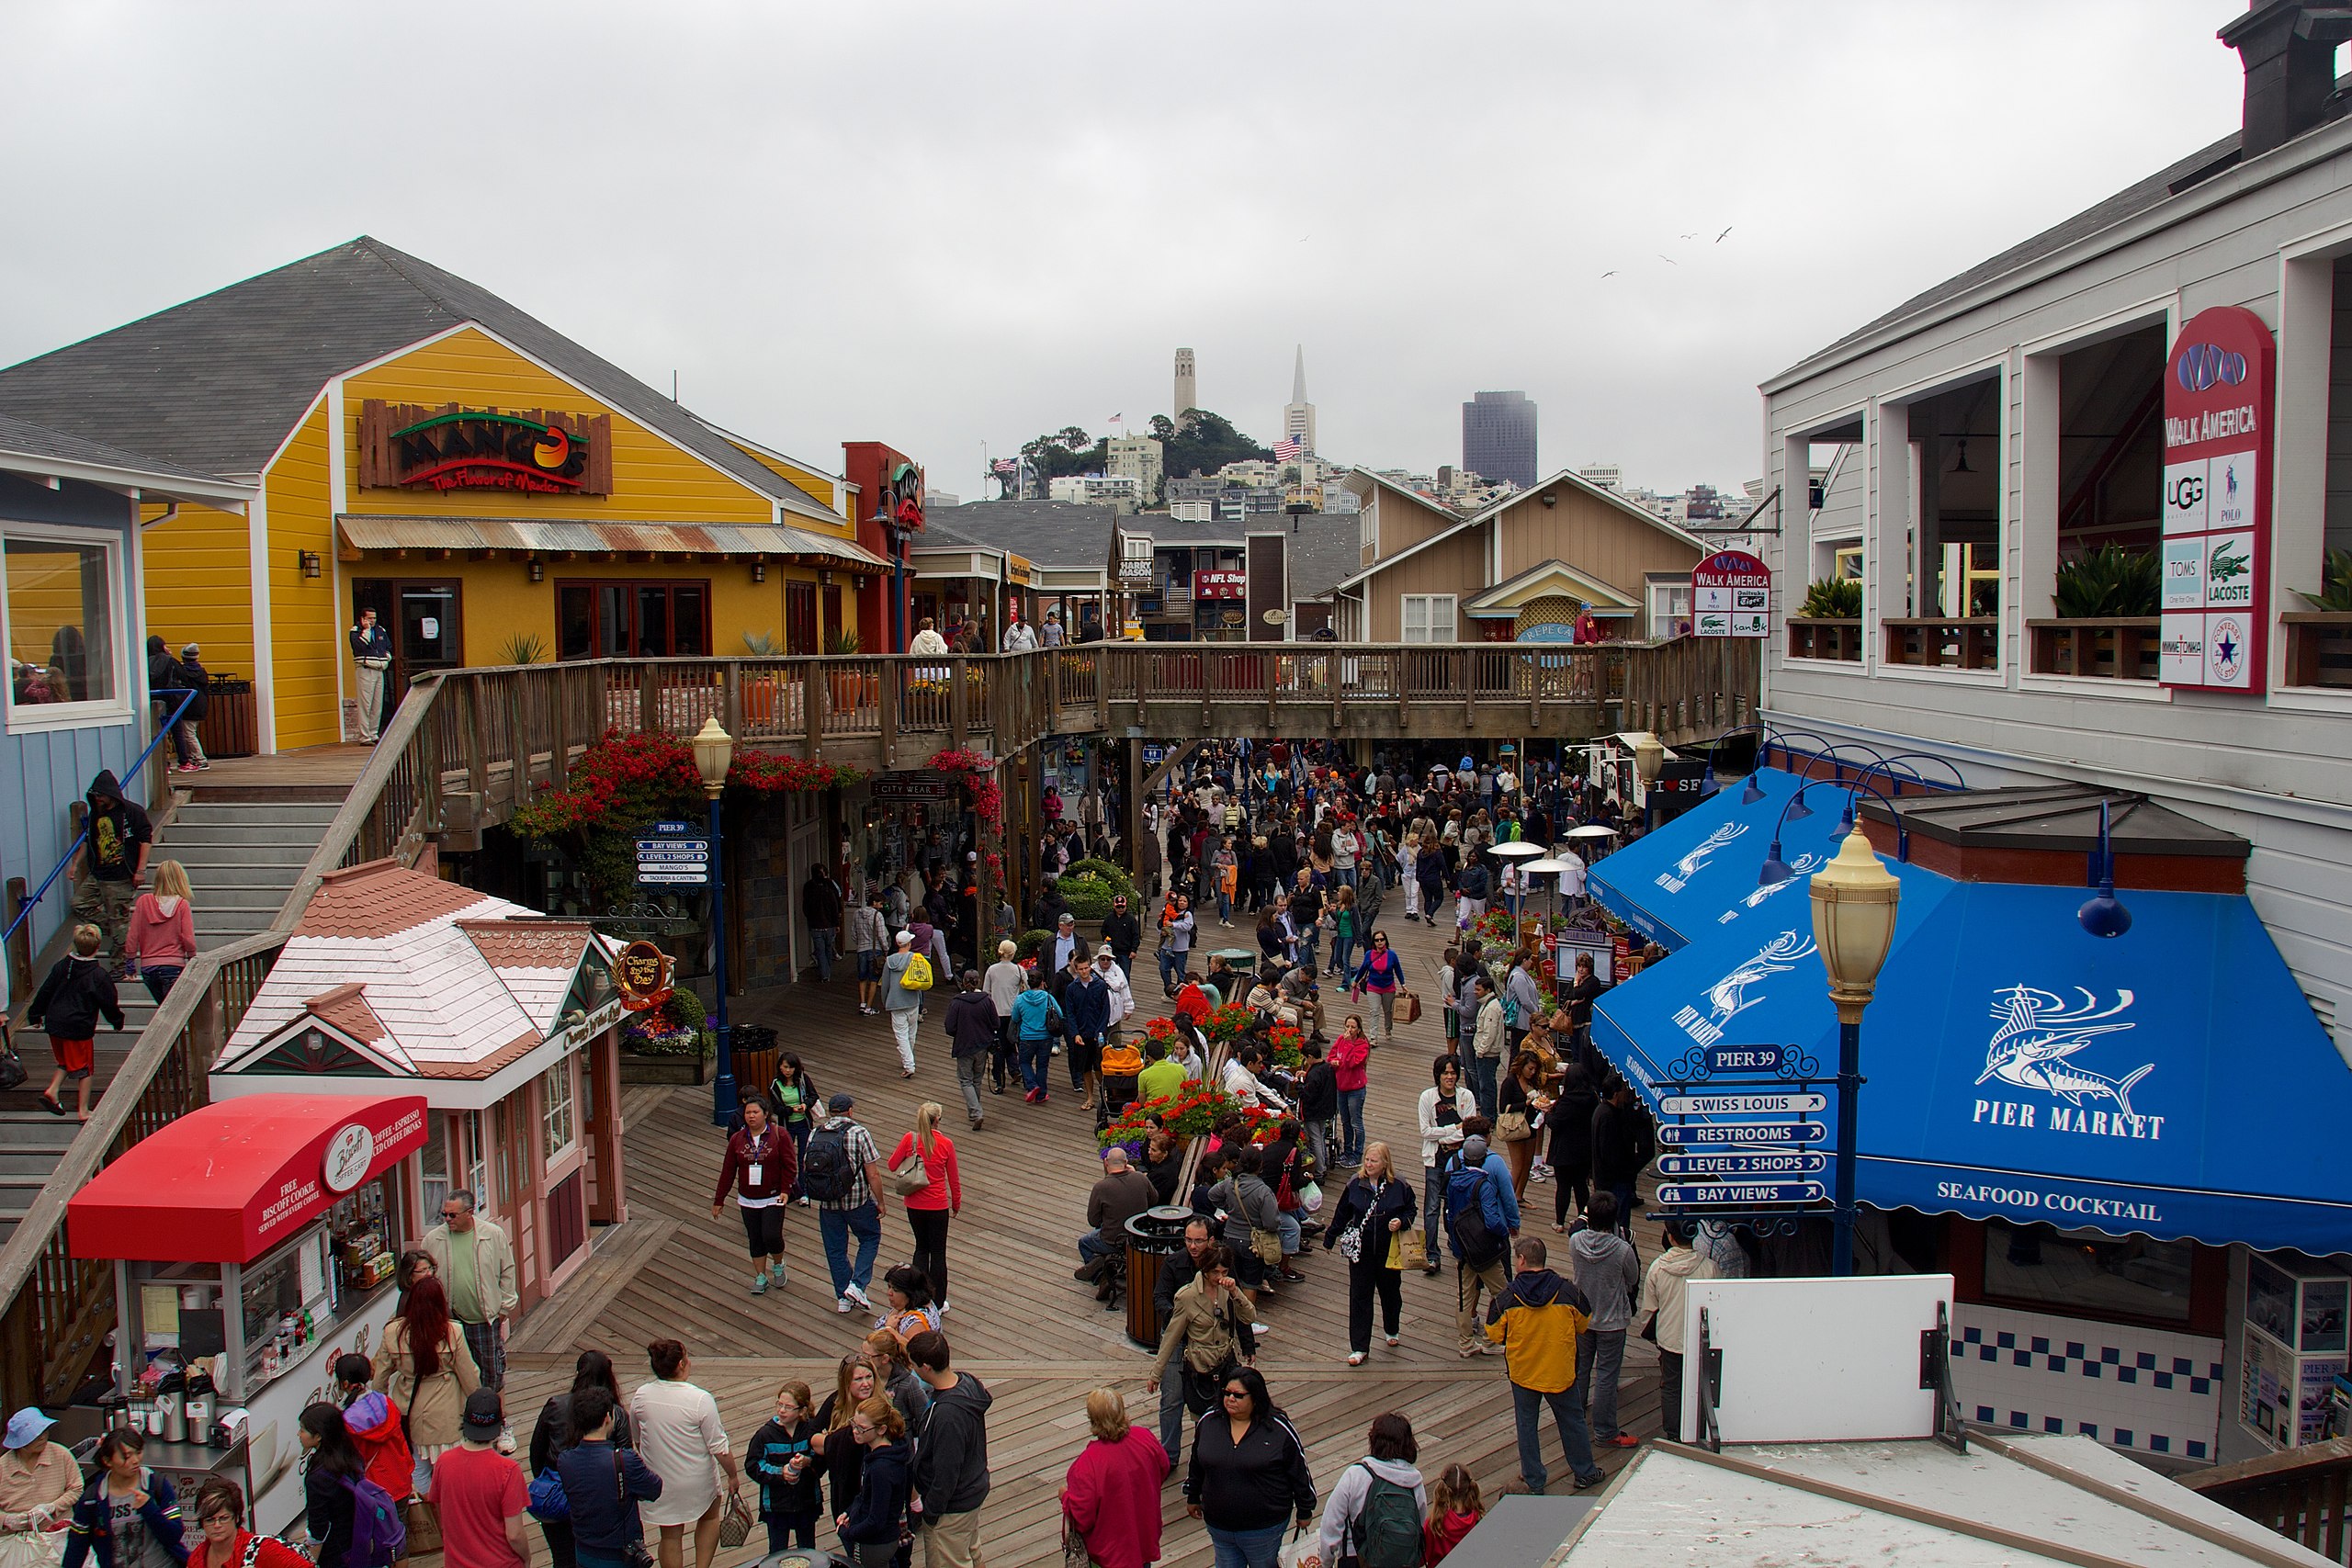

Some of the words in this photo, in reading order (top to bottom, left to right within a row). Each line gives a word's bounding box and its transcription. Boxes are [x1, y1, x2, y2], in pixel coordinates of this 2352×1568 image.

[2165, 416, 2199, 447] WALK
[2200, 405, 2256, 441] AMERICA
[429, 474, 458, 492] The
[458, 468, 499, 488] Flavor
[499, 471, 514, 489] of
[514, 473, 560, 493] Mexico
[2167, 476, 2203, 510] UGG
[2221, 508, 2241, 522] POLO
[1118, 569, 1152, 577] MASON
[1120, 560, 1152, 570] HARRY
[2170, 560, 2196, 577] TOMS
[1210, 573, 1226, 583] NFL
[1227, 573, 1246, 584] Shop
[1696, 572, 1724, 586] WALK
[1726, 573, 1769, 587] AMERICA
[2209, 585, 2249, 602] LACOSTE
[1521, 626, 1555, 642] CREPE
[907, 785, 932, 794] WEAR
[1679, 779, 1702, 792] SF
[626, 955, 660, 965] Charms
[643, 965, 656, 974] the
[633, 974, 655, 985] Bay
[1670, 1004, 1700, 1028] PIER
[1684, 1016, 1724, 1048] MARKET
[1715, 1052, 1756, 1067] PIER
[1758, 1051, 1776, 1066] 39
[1691, 1099, 1739, 1111] SWISS
[1743, 1098, 1789, 1111] LOUIS
[394, 1109, 420, 1132] ESPRESSO
[1973, 1099, 2035, 1129] PIER
[2049, 1106, 2165, 1141] MARKET
[383, 1130, 404, 1150] COFFEE
[403, 1118, 423, 1137] DRINKS
[1696, 1127, 1792, 1141] RESTROOMS
[334, 1168, 354, 1184] COFFEE
[355, 1159, 367, 1172] CART
[1688, 1158, 1734, 1171] LEVEL
[1738, 1158, 1747, 1170] 2
[1751, 1157, 1803, 1170] SHOPS
[280, 1179, 298, 1197] FREE
[1697, 1189, 1727, 1201] BAY
[1730, 1187, 1779, 1200] VIEWS
[263, 1195, 290, 1222] BISCOFF
[290, 1180, 315, 1203] COOKIE
[1937, 1180, 2039, 1208] SEAFOOD
[2043, 1193, 2162, 1222] COCKTAIL
[258, 1217, 277, 1235] SERVED
[277, 1209, 289, 1223] WITH
[288, 1200, 303, 1215] EVERY
[303, 1190, 320, 1206] COFFEE
[2303, 1364, 2329, 1374] PIER
